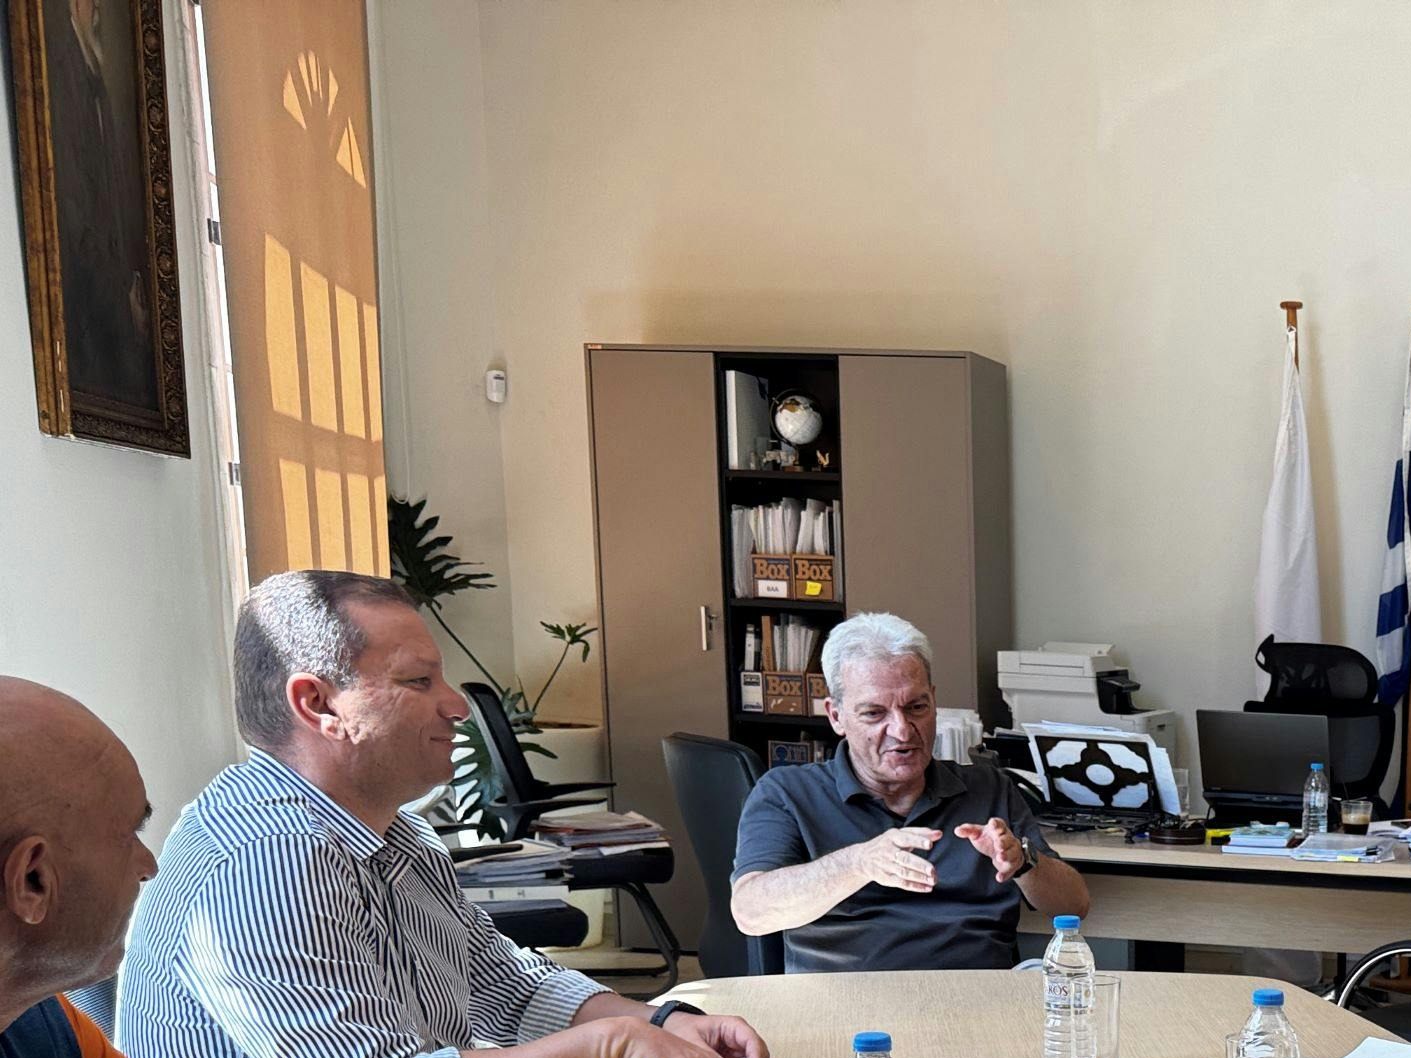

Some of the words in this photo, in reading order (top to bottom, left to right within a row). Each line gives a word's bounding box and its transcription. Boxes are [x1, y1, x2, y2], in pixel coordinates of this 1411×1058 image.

[753, 558, 790, 580] Box
[795, 559, 832, 580] Box
[766, 675, 802, 696] Box
